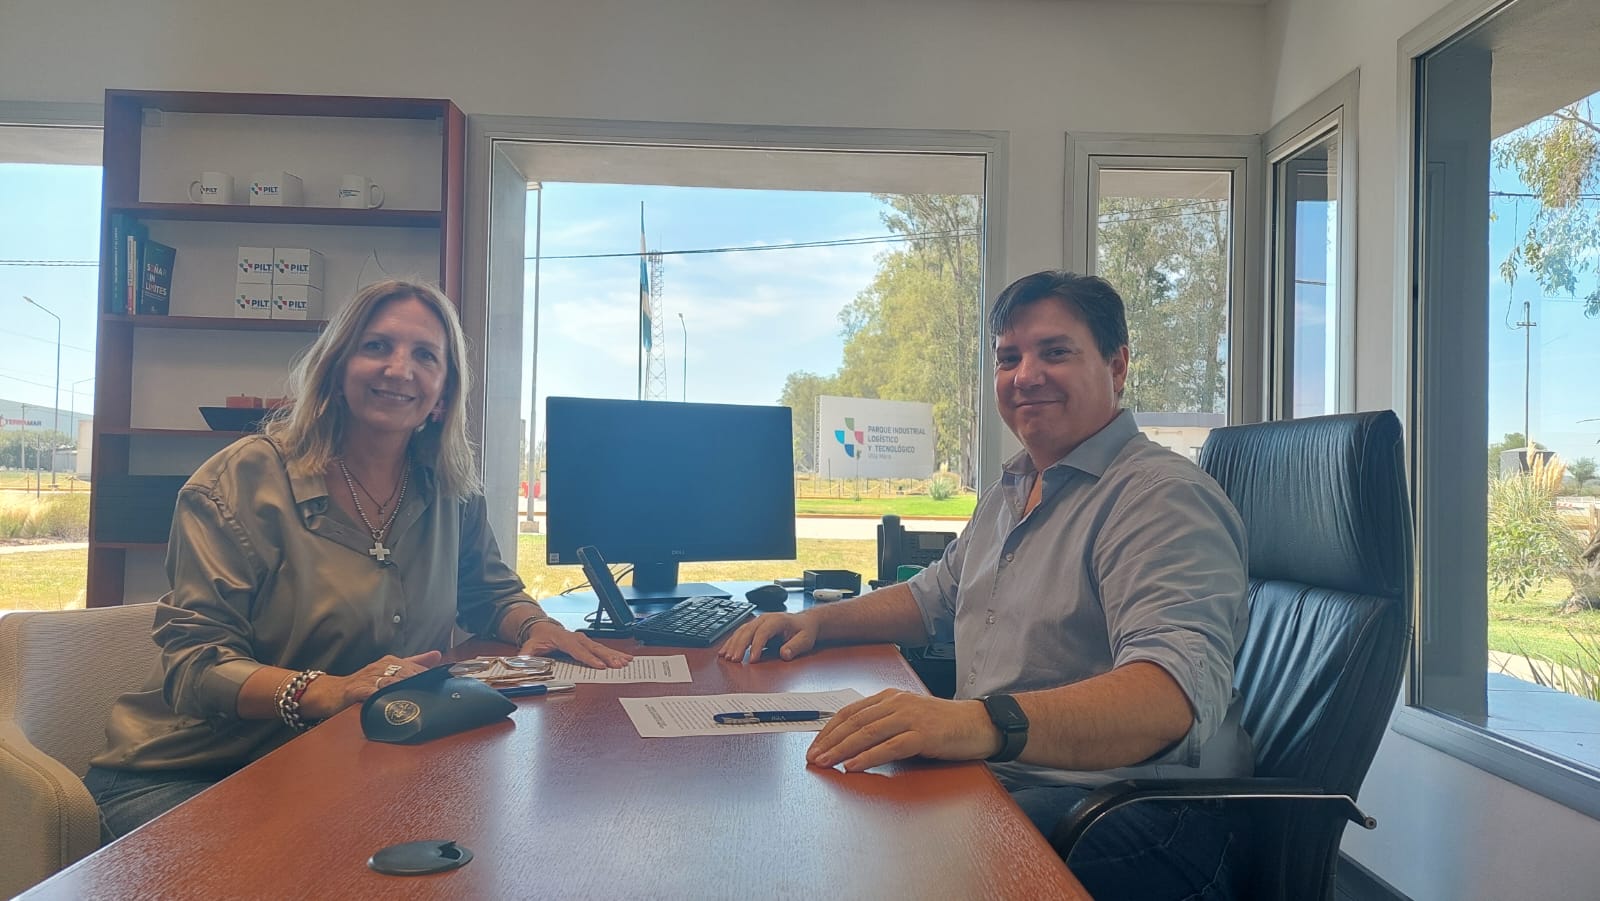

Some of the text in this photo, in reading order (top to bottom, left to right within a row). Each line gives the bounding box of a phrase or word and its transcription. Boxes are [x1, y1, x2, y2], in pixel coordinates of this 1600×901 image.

[254, 263, 272, 271] PILT
[290, 264, 309, 272] PILT
[251, 299, 270, 308] PILT
[288, 300, 307, 309] PILT
[868, 426, 926, 435] PARQUE INDUSTRIAL
[868, 435, 899, 443] LOGÍSTICO
[876, 444, 915, 453] TECNOLÓGICO
